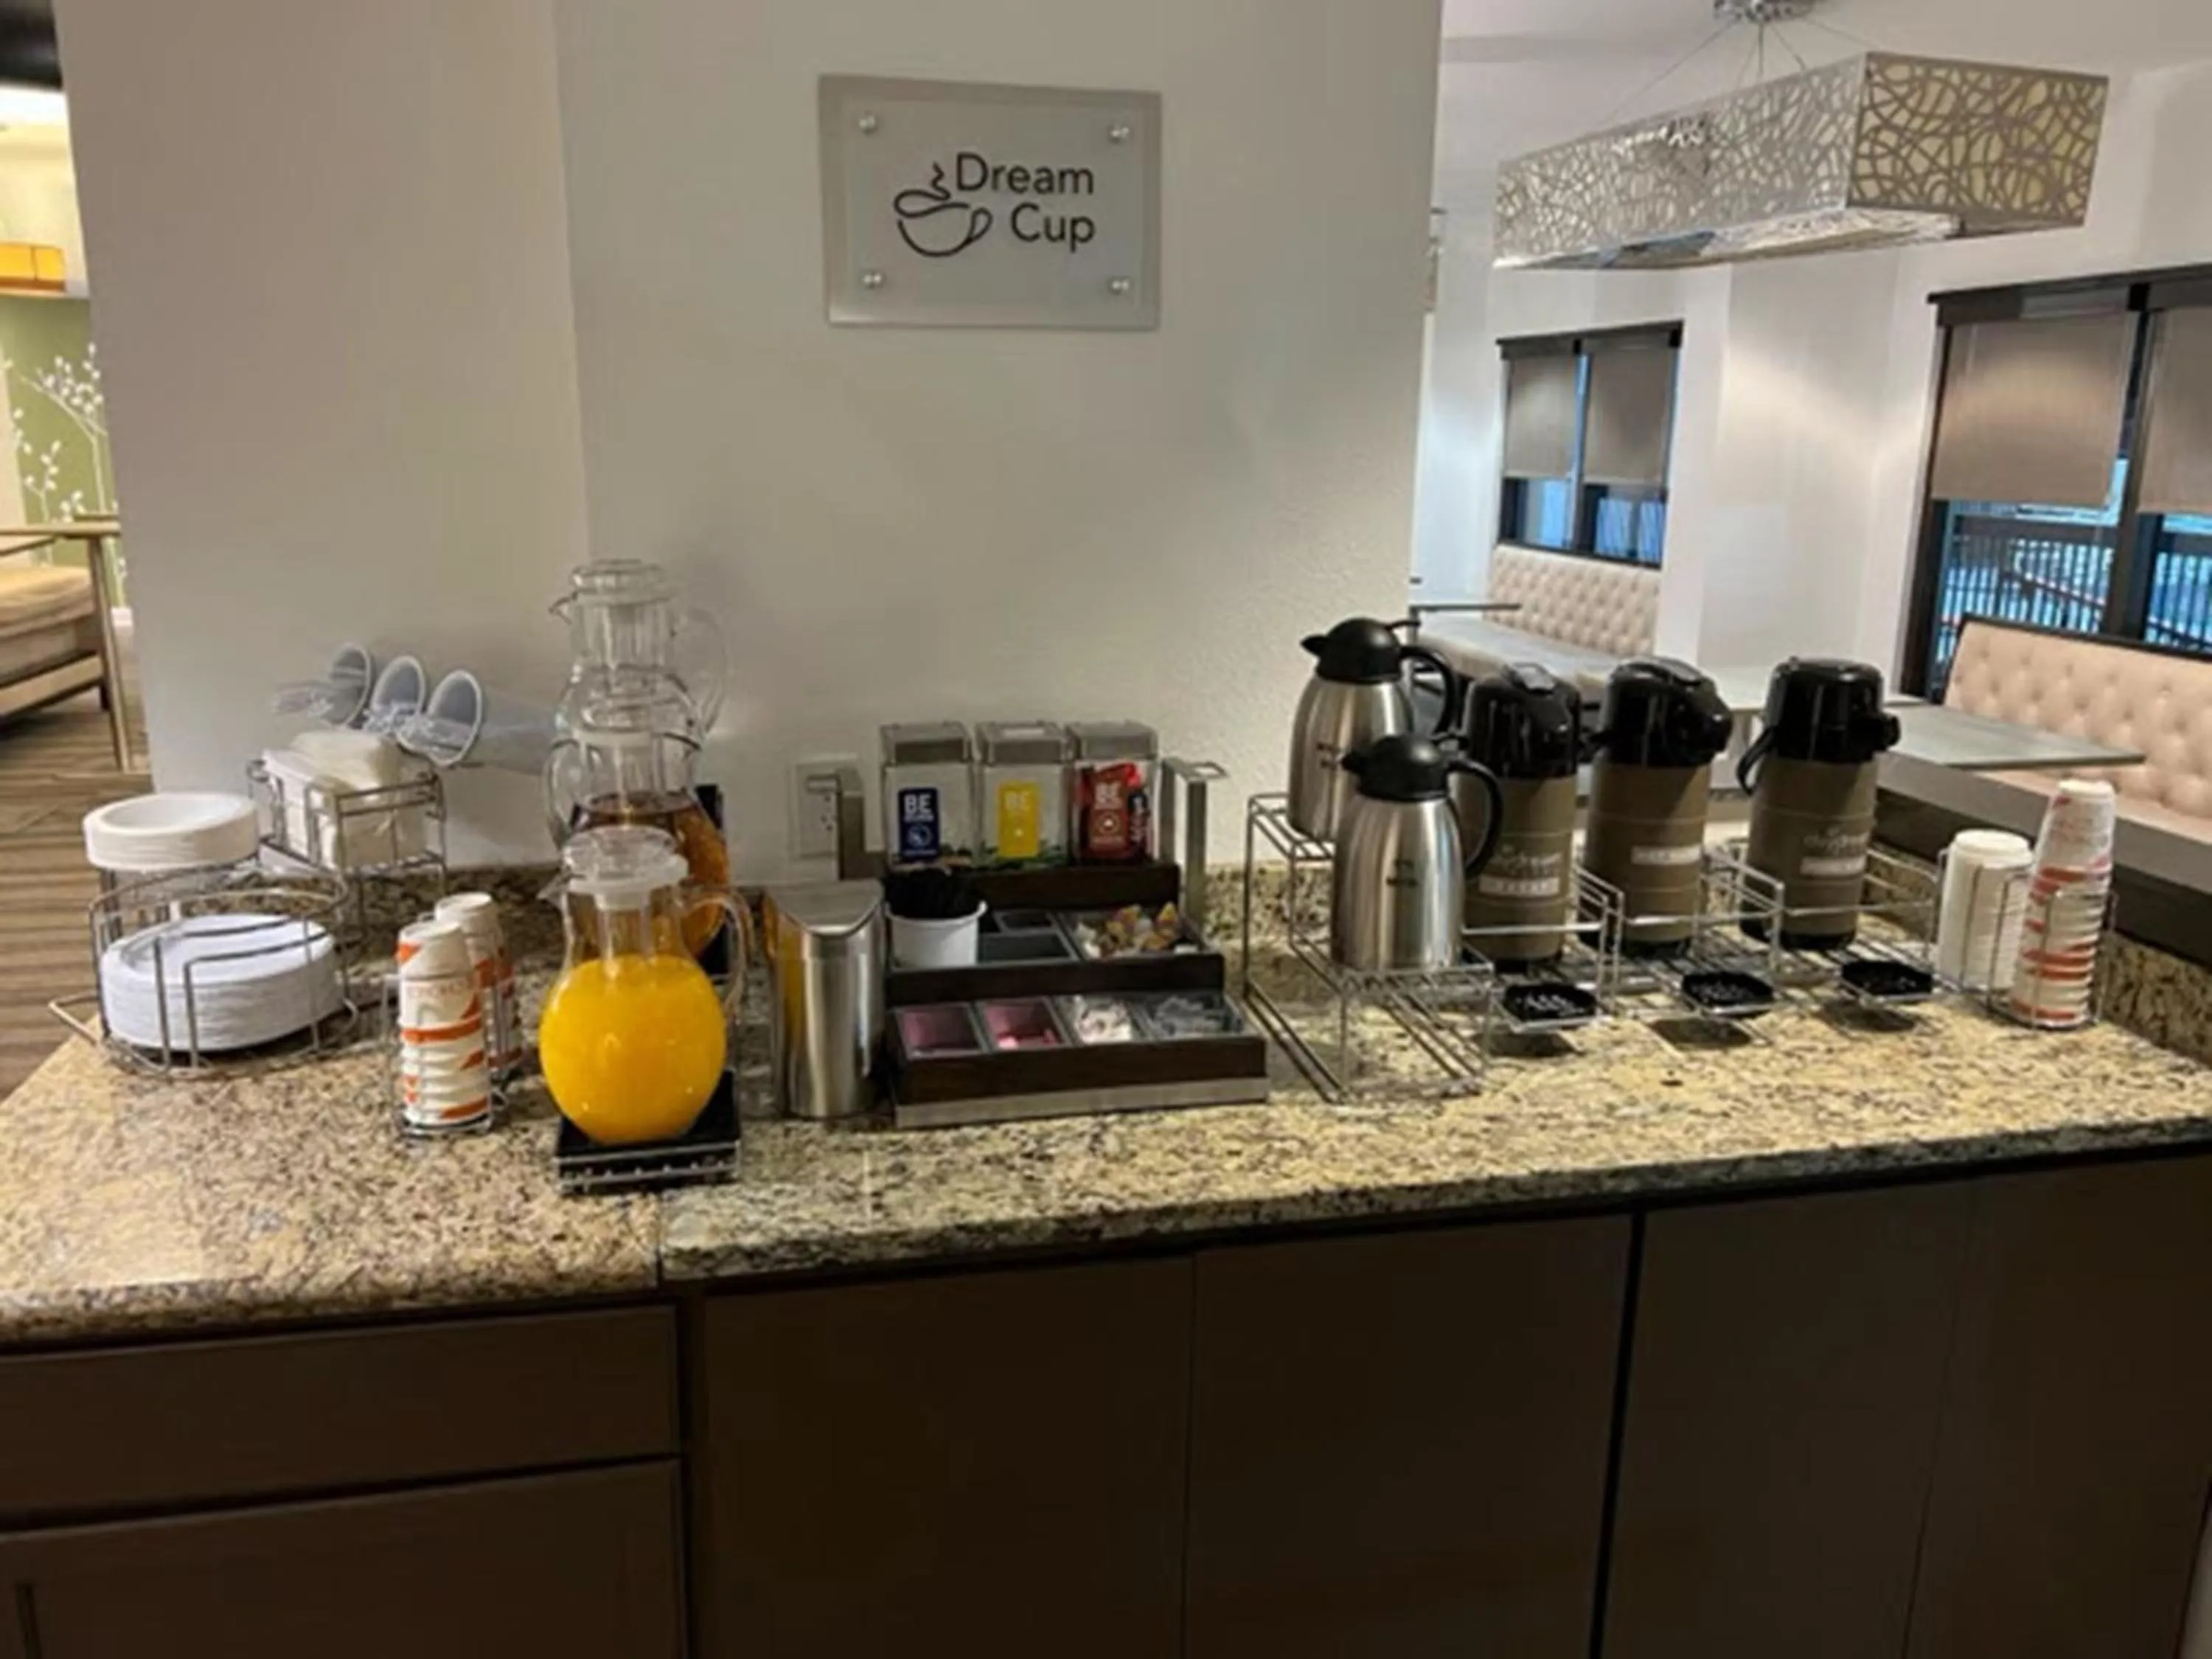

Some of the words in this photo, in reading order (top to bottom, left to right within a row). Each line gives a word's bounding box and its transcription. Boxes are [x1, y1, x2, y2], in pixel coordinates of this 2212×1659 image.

[956, 151, 1094, 195] Dream
[1010, 201, 1096, 254] Cup
[903, 793, 933, 813] BE
[1004, 790, 1032, 810] BE
